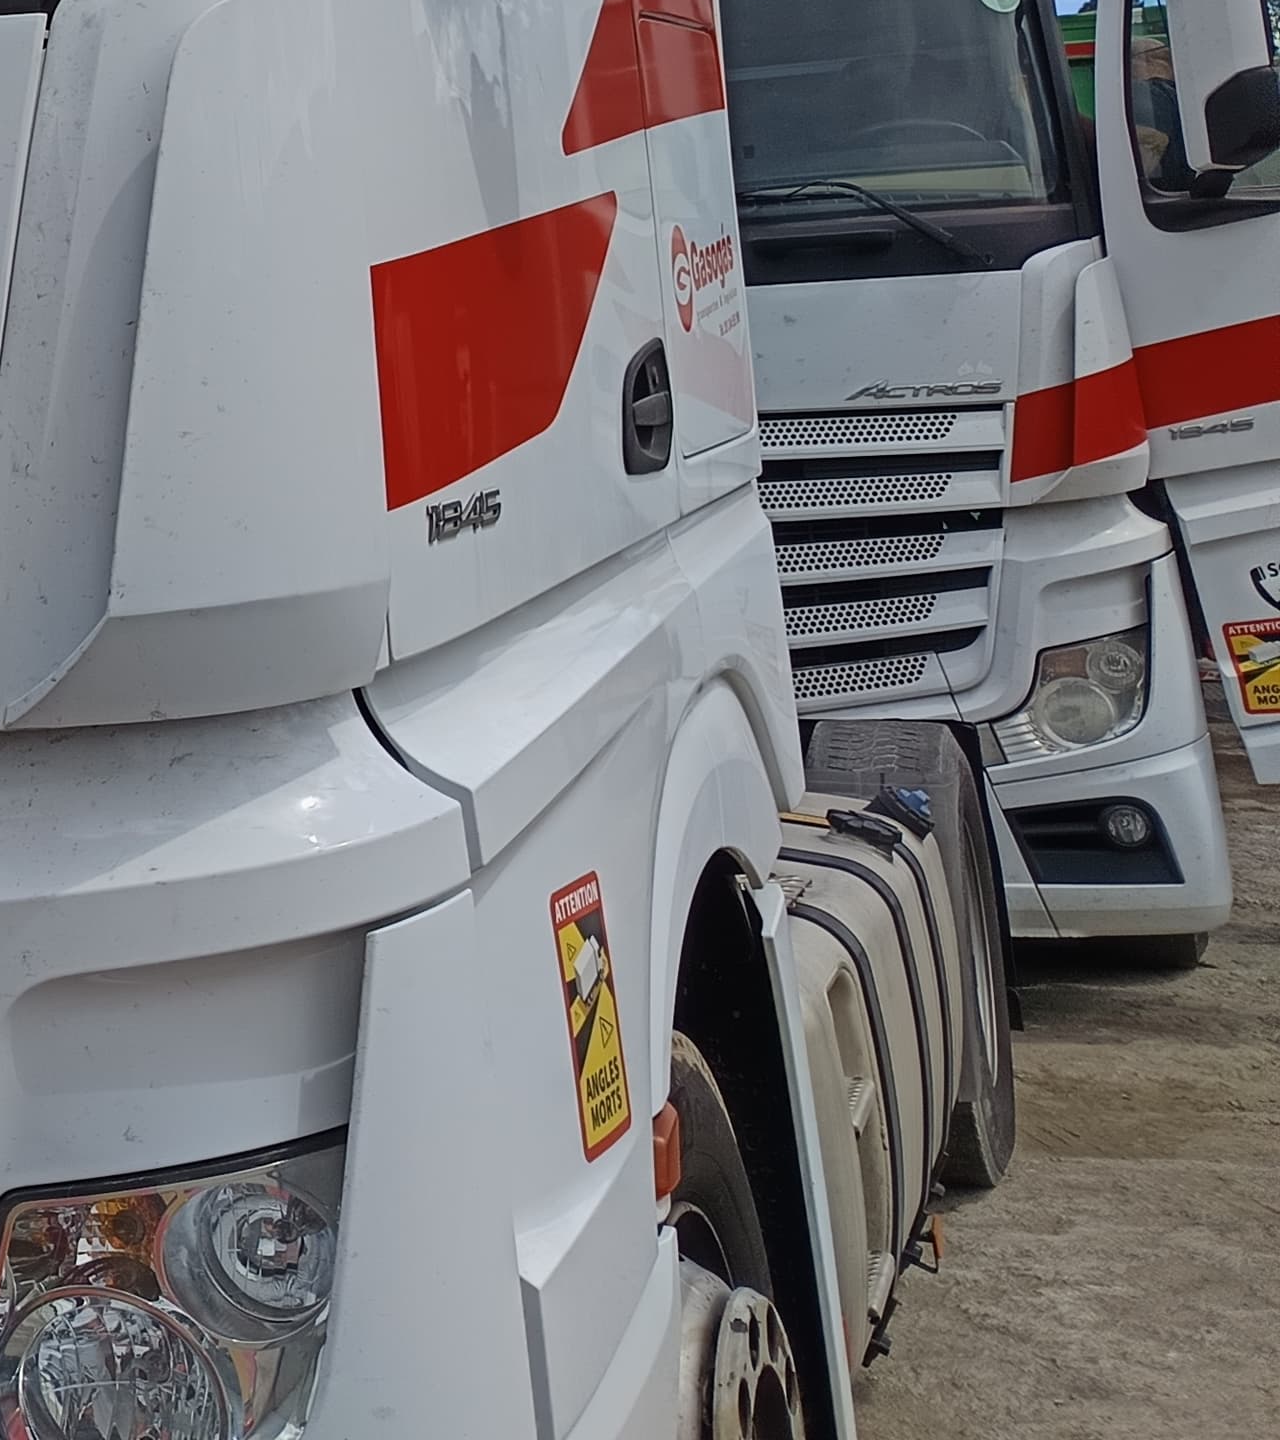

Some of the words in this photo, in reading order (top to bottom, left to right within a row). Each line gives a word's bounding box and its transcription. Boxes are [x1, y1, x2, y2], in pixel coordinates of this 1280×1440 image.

[844, 377, 1004, 401] ACTROS
[1168, 416, 1256, 441] 1845
[426, 488, 502, 546] 1845
[554, 880, 600, 924] ATTENTION
[586, 1055, 621, 1103] ANGLES
[590, 1085, 623, 1132] MORTS
